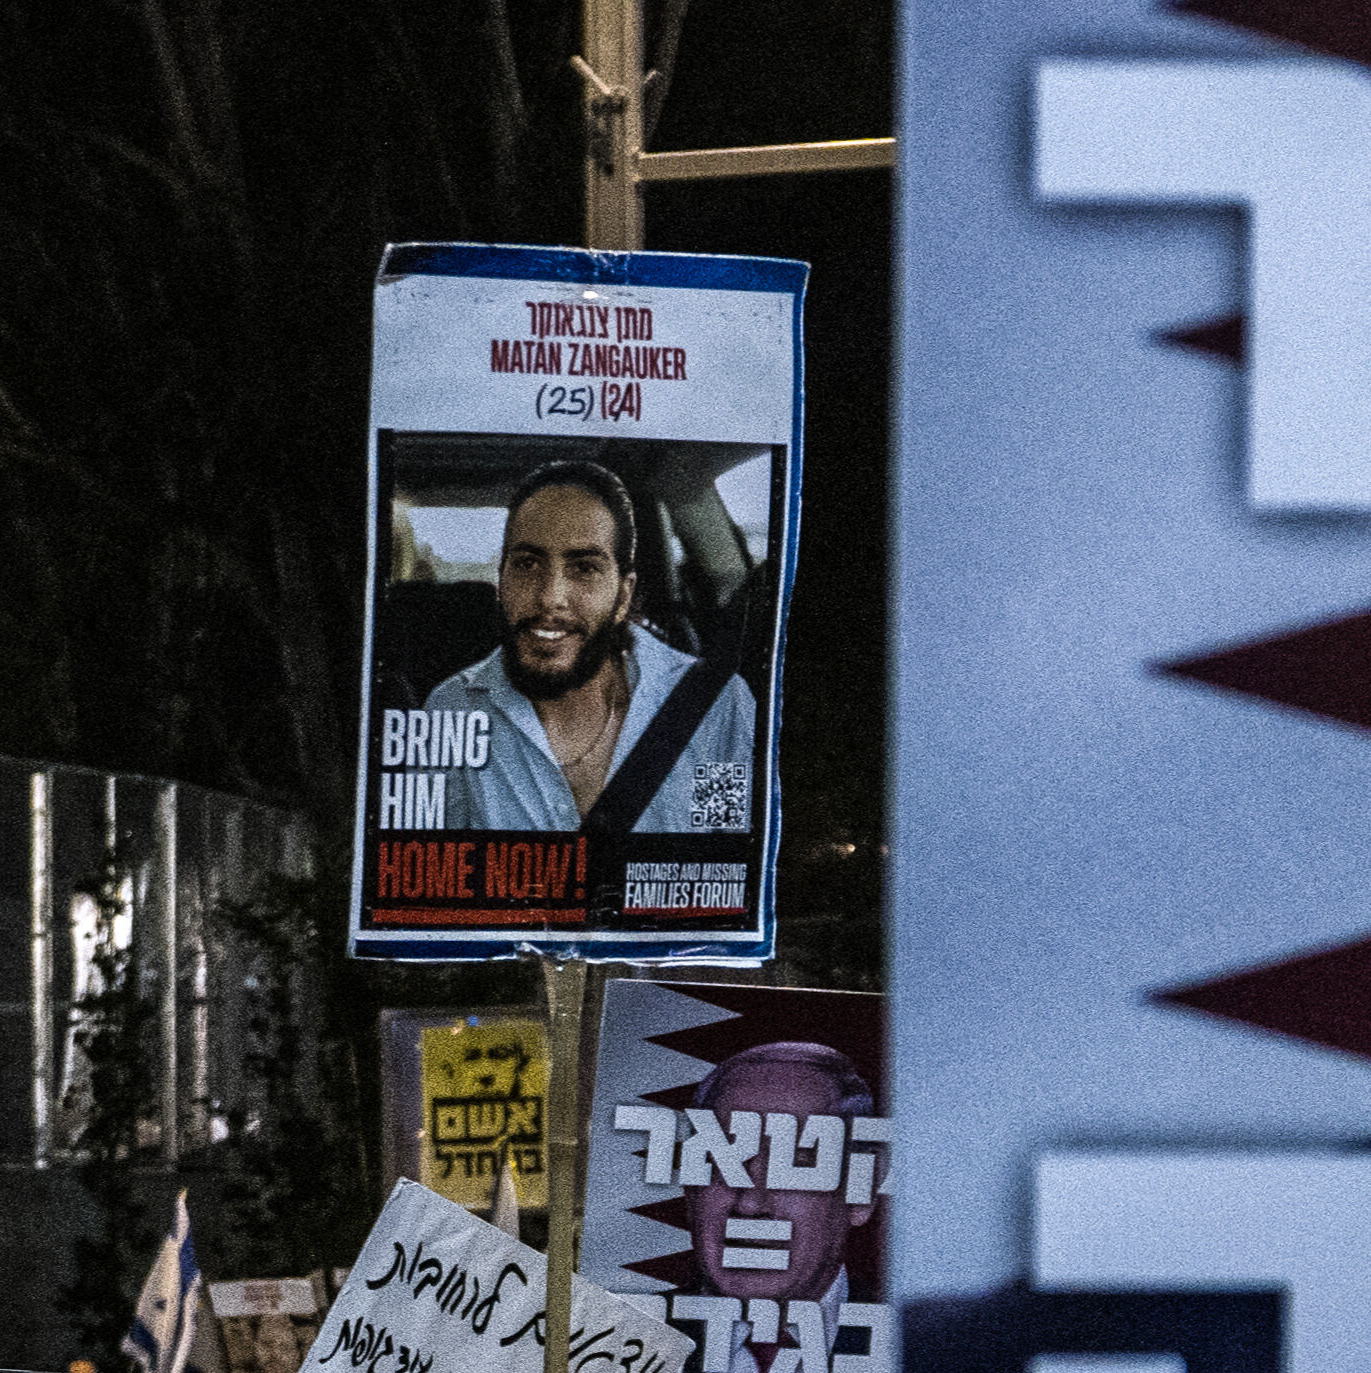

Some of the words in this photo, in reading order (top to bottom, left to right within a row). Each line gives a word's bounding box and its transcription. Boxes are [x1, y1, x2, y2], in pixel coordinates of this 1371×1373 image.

[526, 301, 609, 339] צנגאוקר
[615, 306, 653, 343] מתן
[491, 339, 562, 375] MATAN
[567, 343, 687, 380] ZANGAUKER
[535, 383, 595, 420] (25)
[600, 380, 642, 422] (24)
[382, 708, 491, 768] BRING
[380, 772, 447, 831] HIM
[377, 841, 476, 899] HOME
[484, 837, 587, 900] NOW!
[626, 862, 680, 881] HOSTAGES
[680, 863, 701, 881] AND
[702, 863, 747, 880] MISSING
[624, 882, 691, 908] FAMILIES
[692, 882, 746, 908] FORUM
[614, 1105, 892, 1205] קטאר
